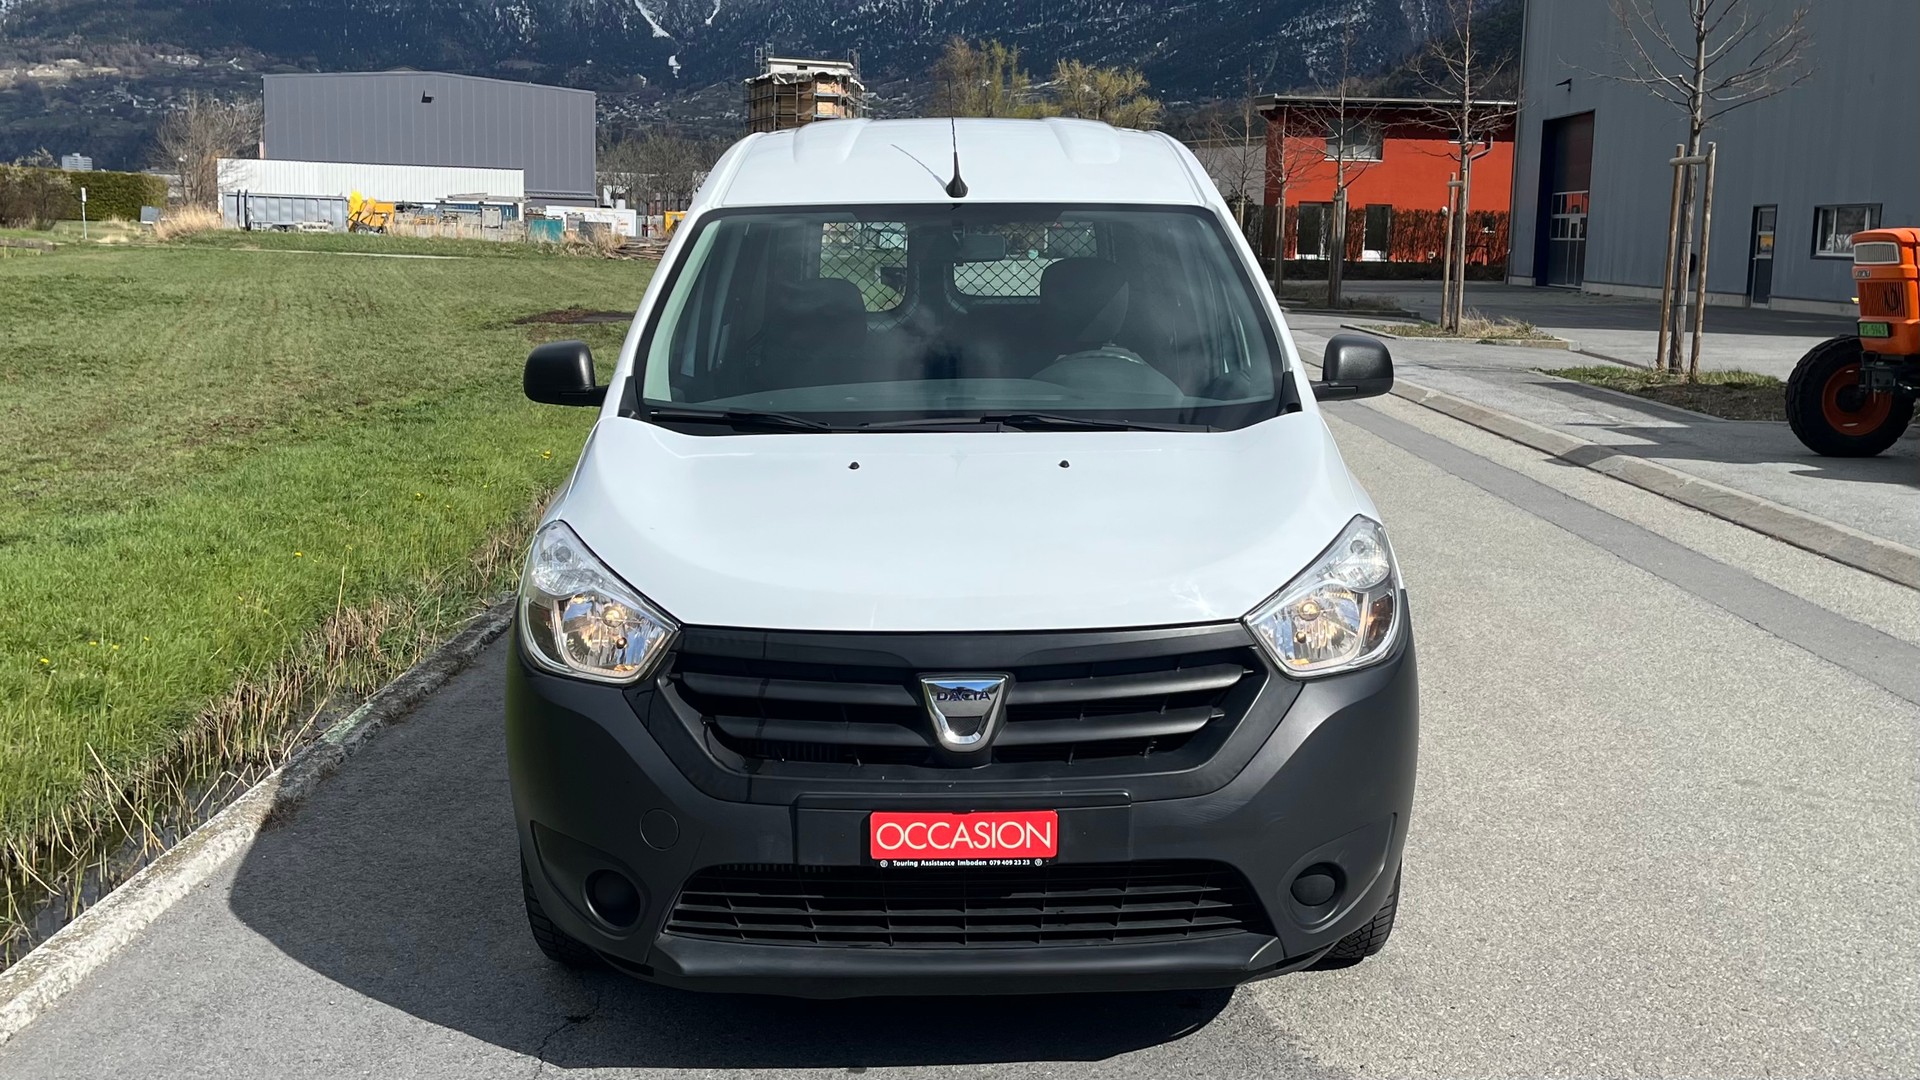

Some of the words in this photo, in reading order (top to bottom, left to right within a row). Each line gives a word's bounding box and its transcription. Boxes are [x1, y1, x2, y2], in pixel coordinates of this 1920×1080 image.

[937, 691, 991, 701] DACIA
[876, 821, 1051, 850] OCCASION
[893, 860, 919, 868] Touring
